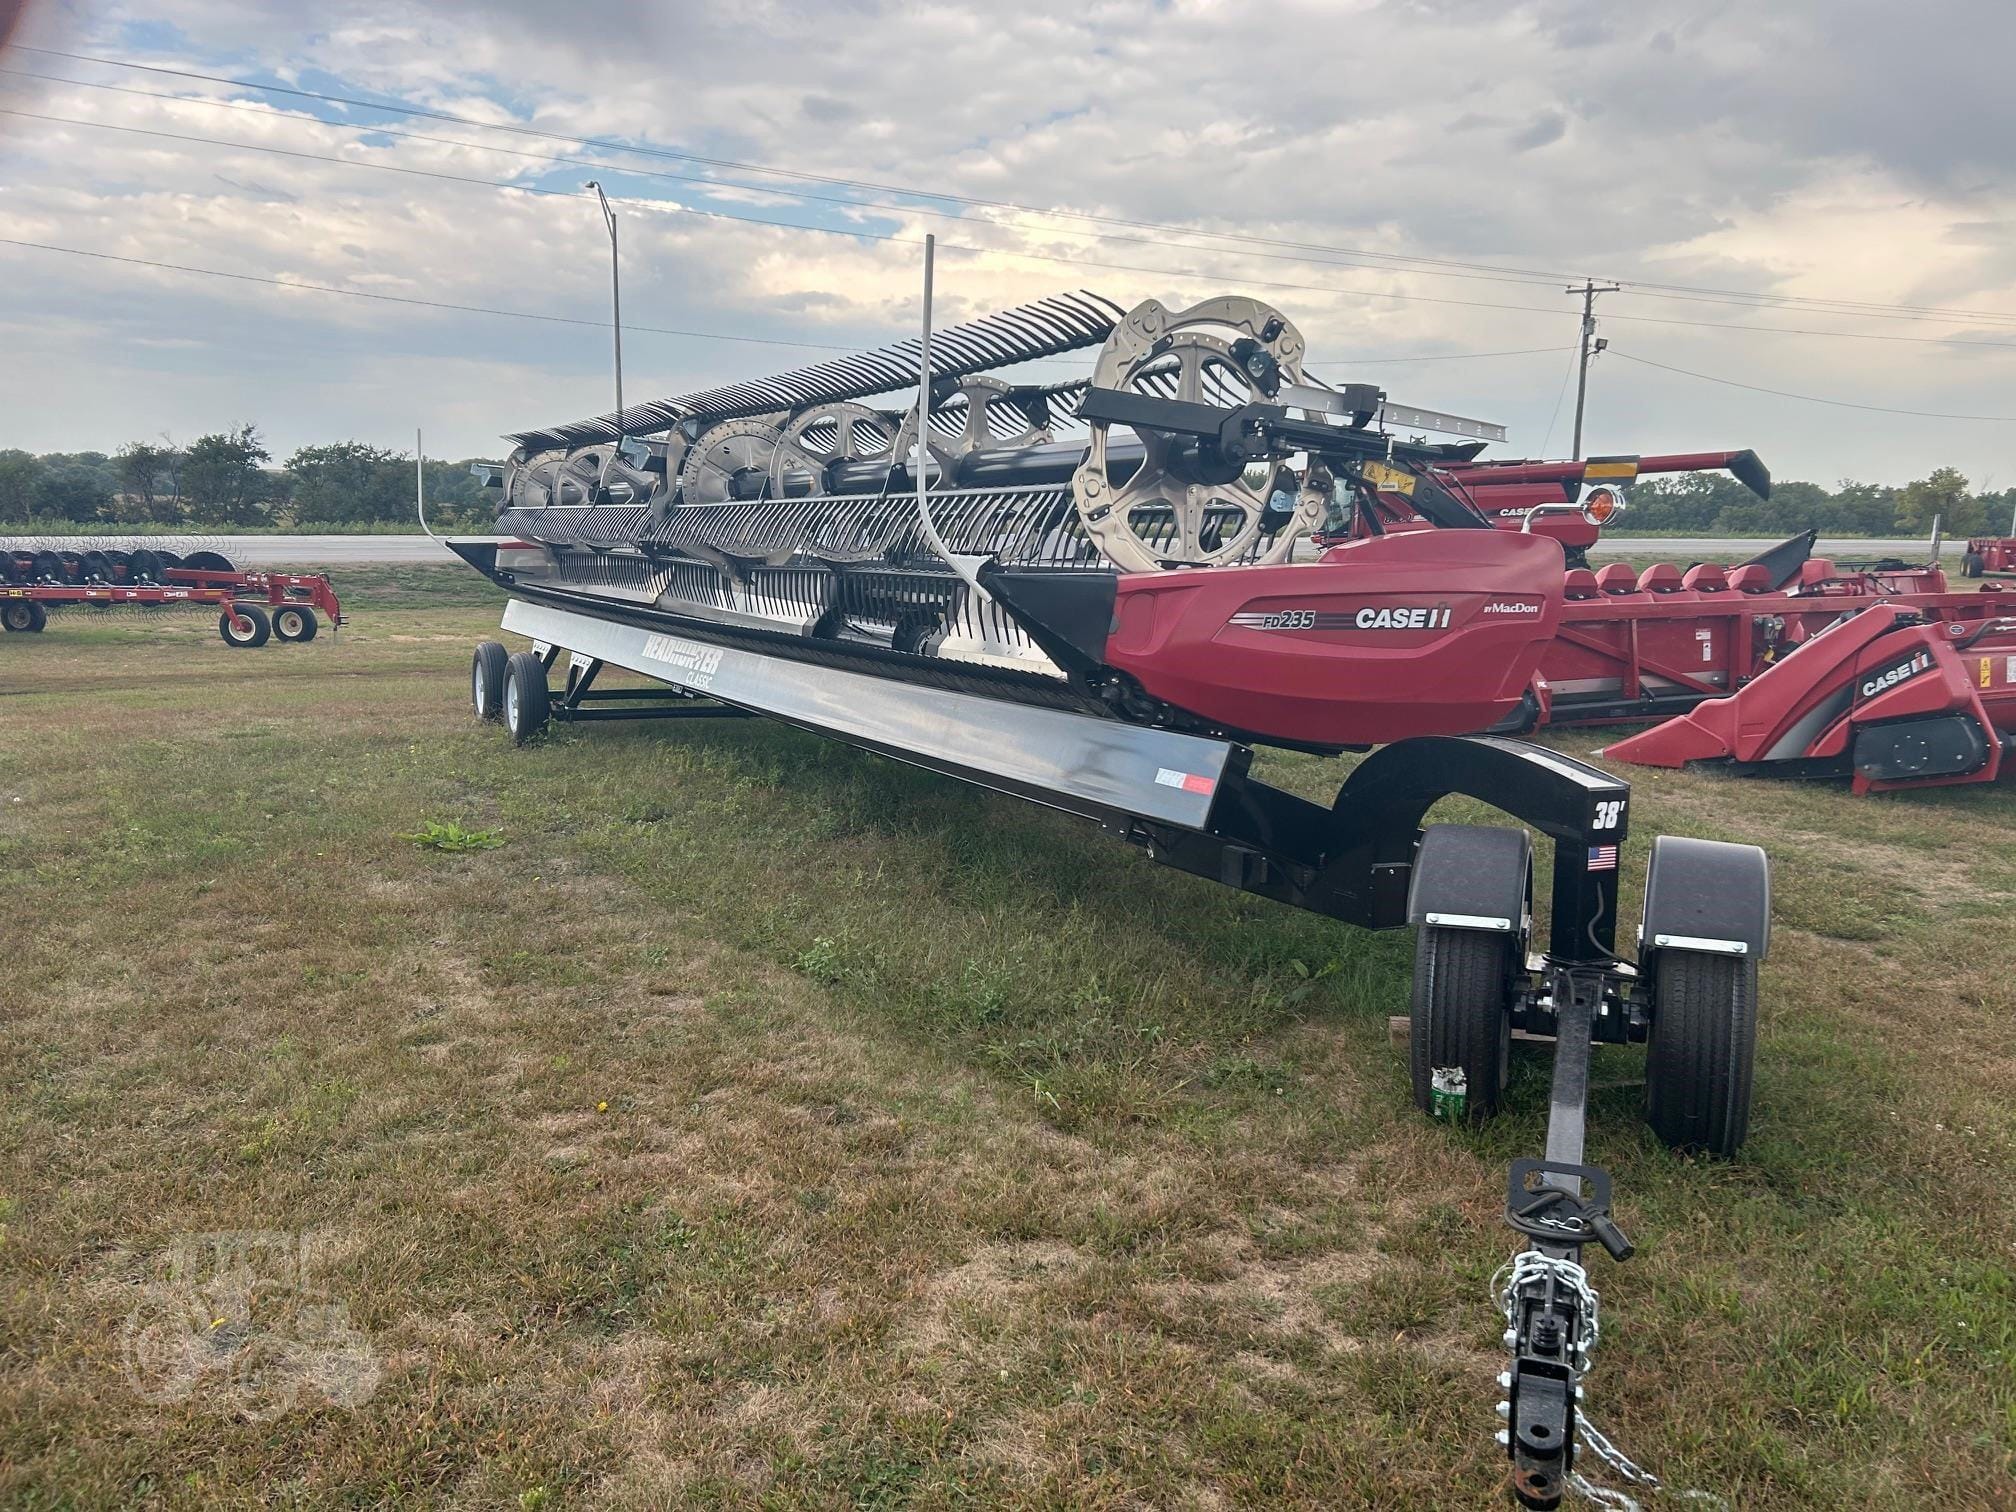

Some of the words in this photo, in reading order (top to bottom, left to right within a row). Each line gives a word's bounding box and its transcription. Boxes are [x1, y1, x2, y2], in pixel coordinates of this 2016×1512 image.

[1492, 603, 1538, 613] MacDon
[1355, 608, 1427, 629] CASE
[685, 671, 713, 689] CLASSIC
[1862, 662, 1912, 697] CASE
